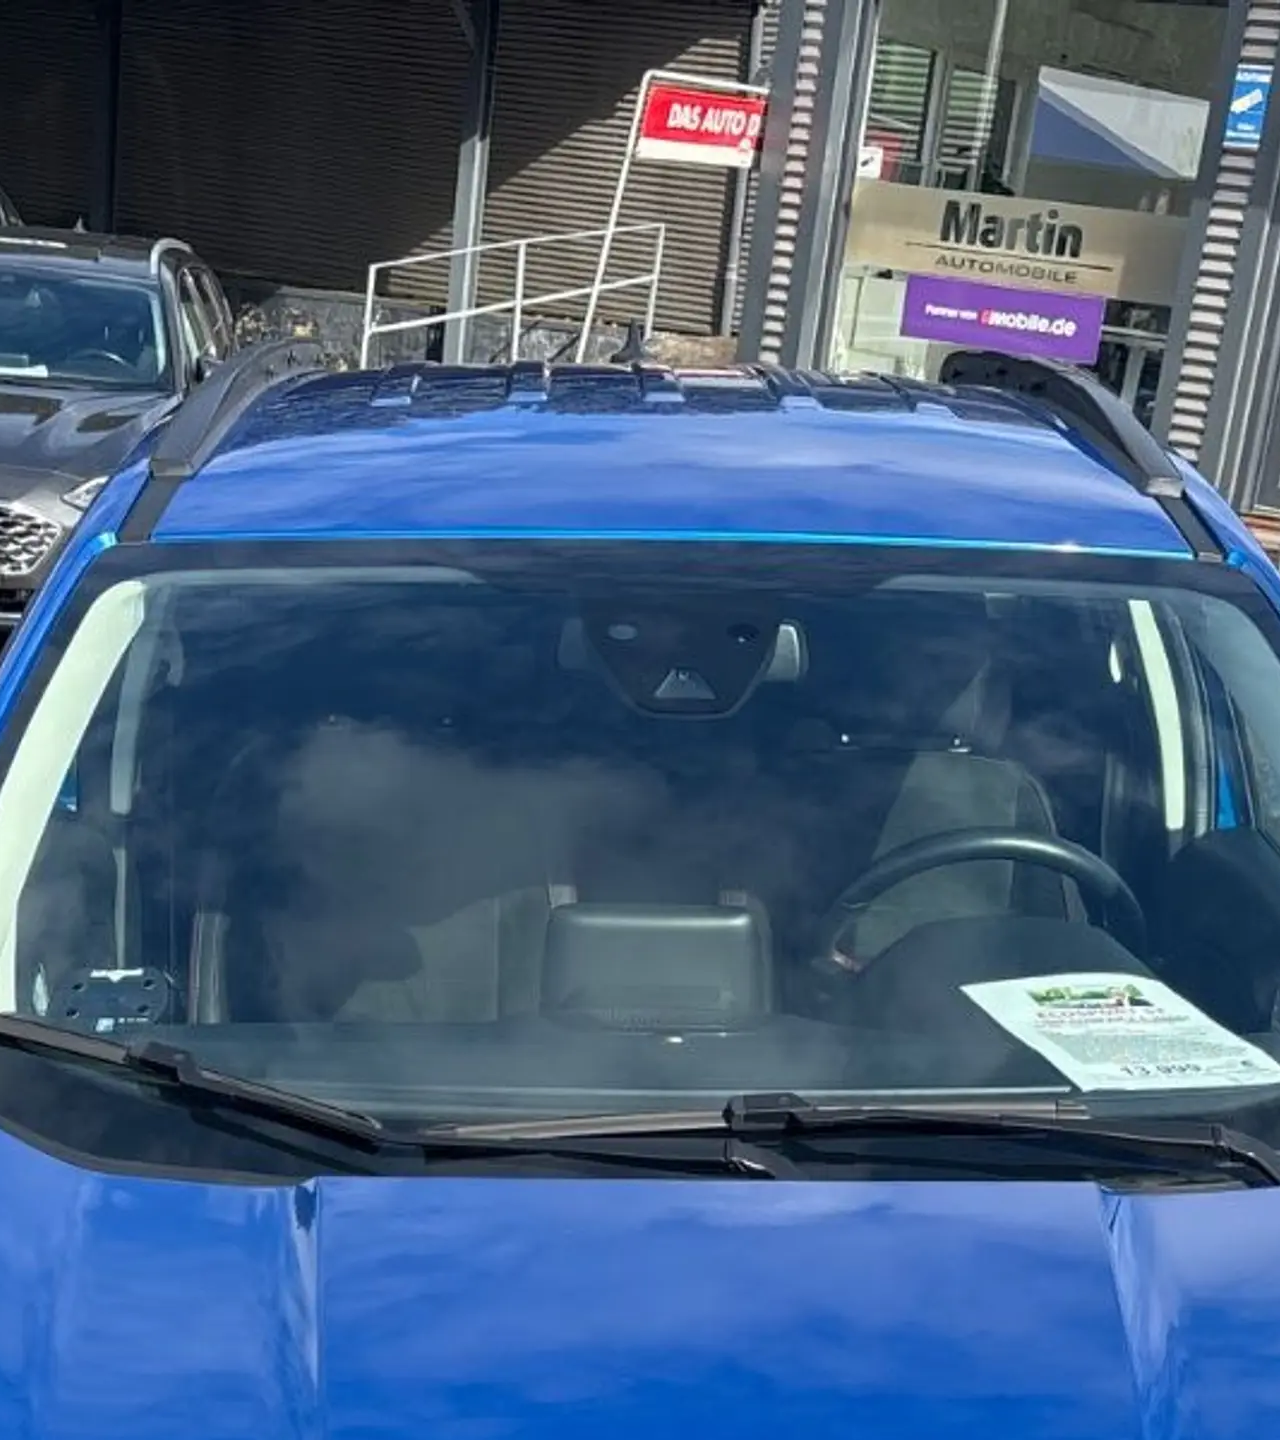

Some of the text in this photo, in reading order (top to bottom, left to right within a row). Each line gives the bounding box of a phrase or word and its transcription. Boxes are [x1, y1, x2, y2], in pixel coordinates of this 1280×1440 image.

[666, 103, 702, 131] DAS
[700, 107, 746, 136] AUTO
[940, 199, 1083, 258] Martin
[935, 253, 1078, 284] AUTOMOBILE
